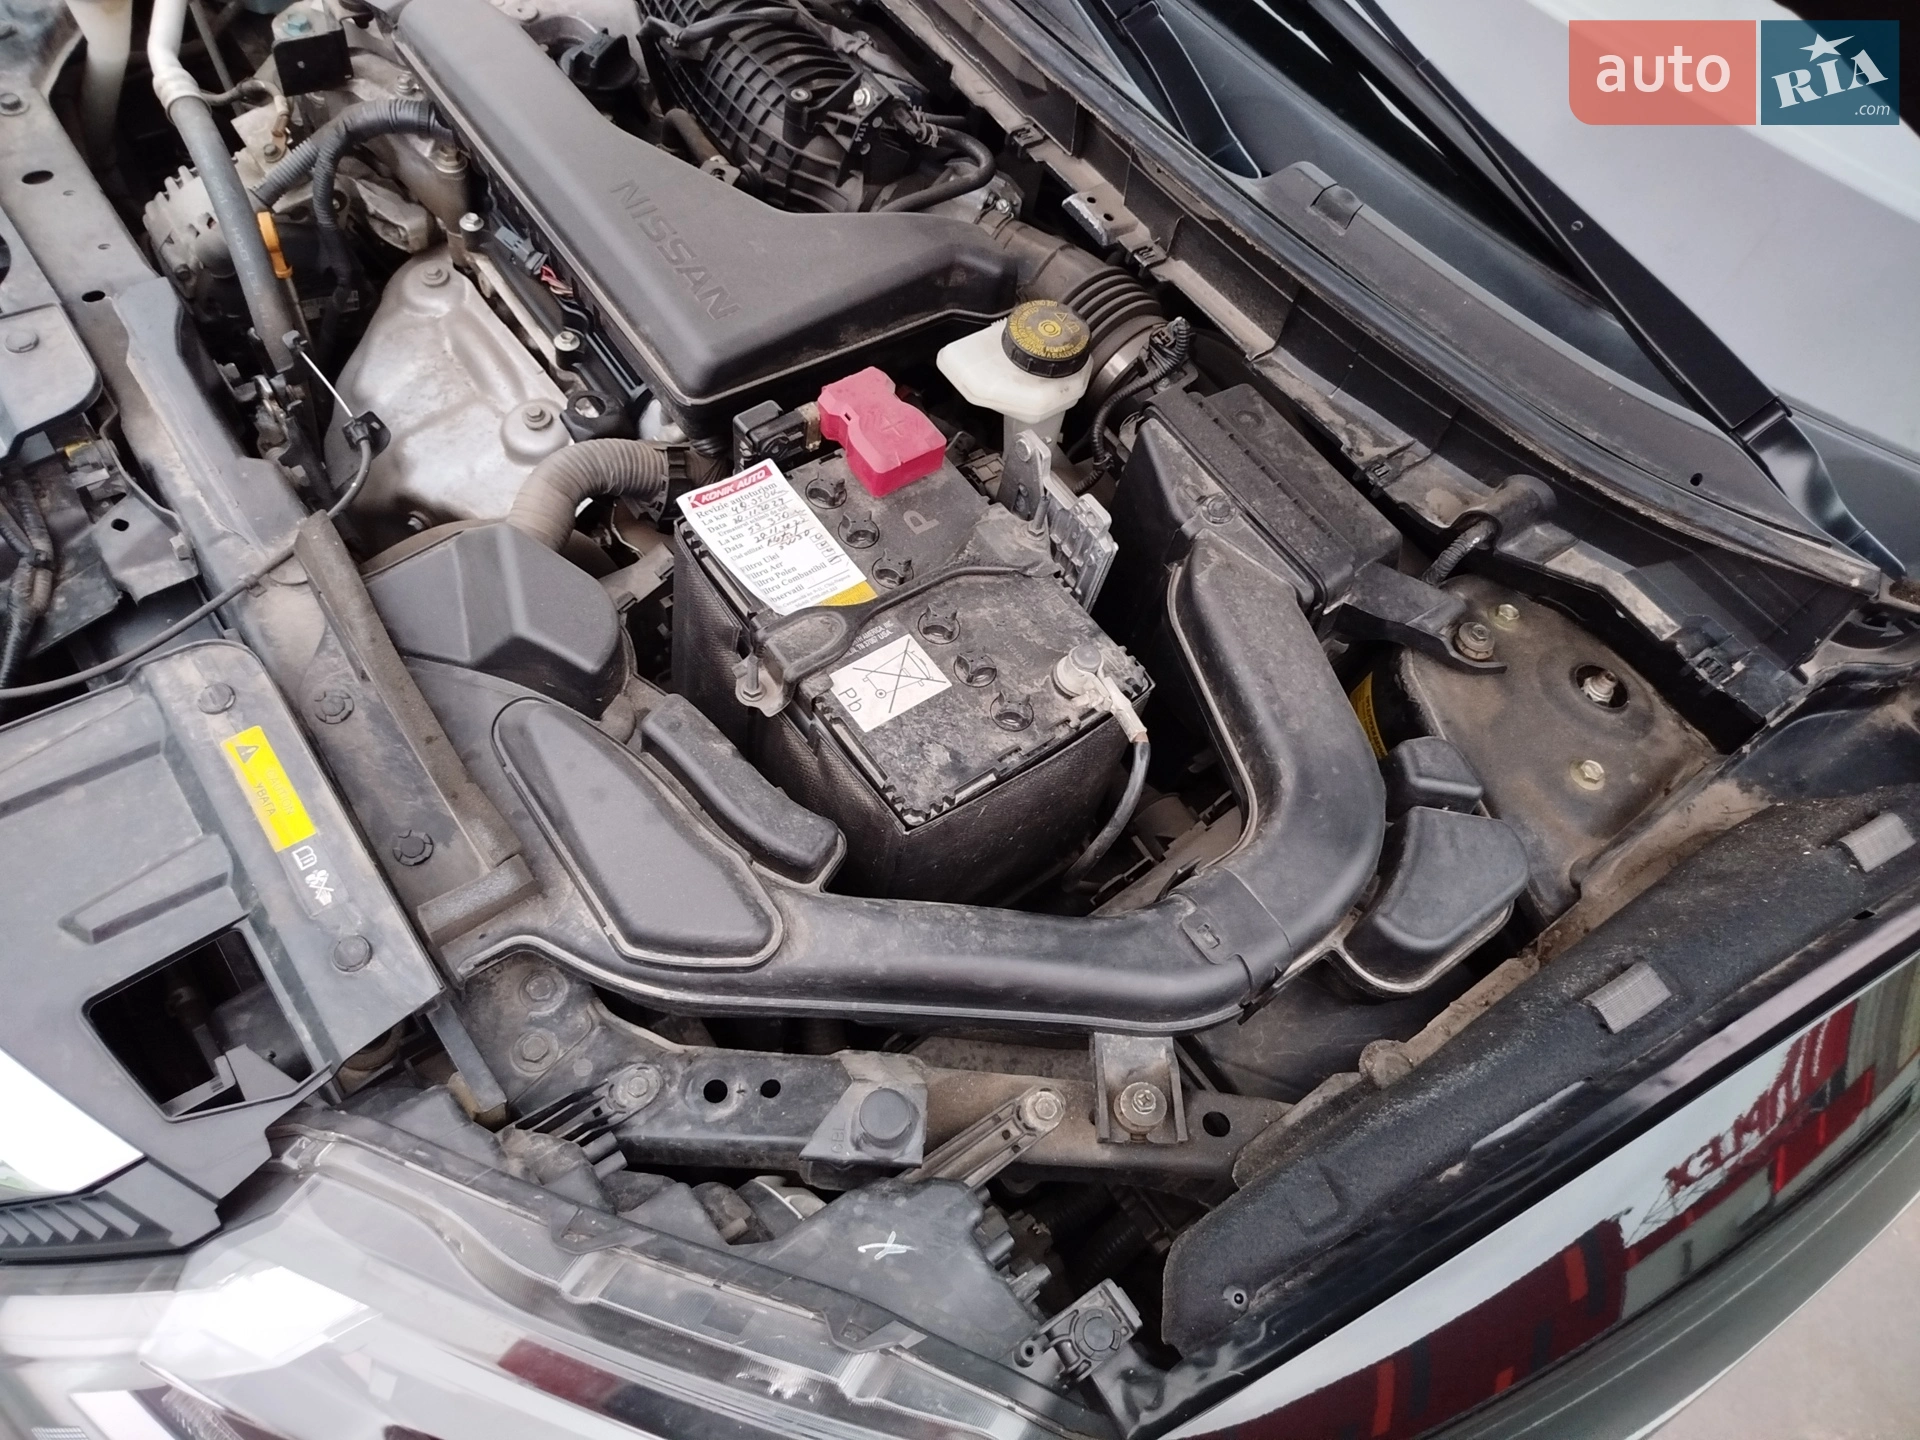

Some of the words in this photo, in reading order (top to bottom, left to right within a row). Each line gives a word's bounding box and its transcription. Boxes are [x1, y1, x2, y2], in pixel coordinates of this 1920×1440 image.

[610, 179, 742, 321] NISSAN
[701, 484, 735, 503] KONIK
[736, 470, 766, 490] AUTO
[696, 501, 729, 519] Revizie
[731, 482, 778, 505] autoturism
[701, 518, 712, 526] La
[714, 511, 728, 522] km
[707, 522, 727, 533] Data
[718, 539, 729, 547] La
[730, 532, 744, 543] km
[724, 543, 744, 554] Data
[763, 552, 780, 564] Ulei
[770, 561, 784, 572] Aer
[775, 566, 797, 579] Polen
[781, 562, 827, 586] Combustibil
[838, 687, 862, 712] Pb
[254, 783, 277, 816] УВАГА
[266, 768, 295, 815] CAUTION
